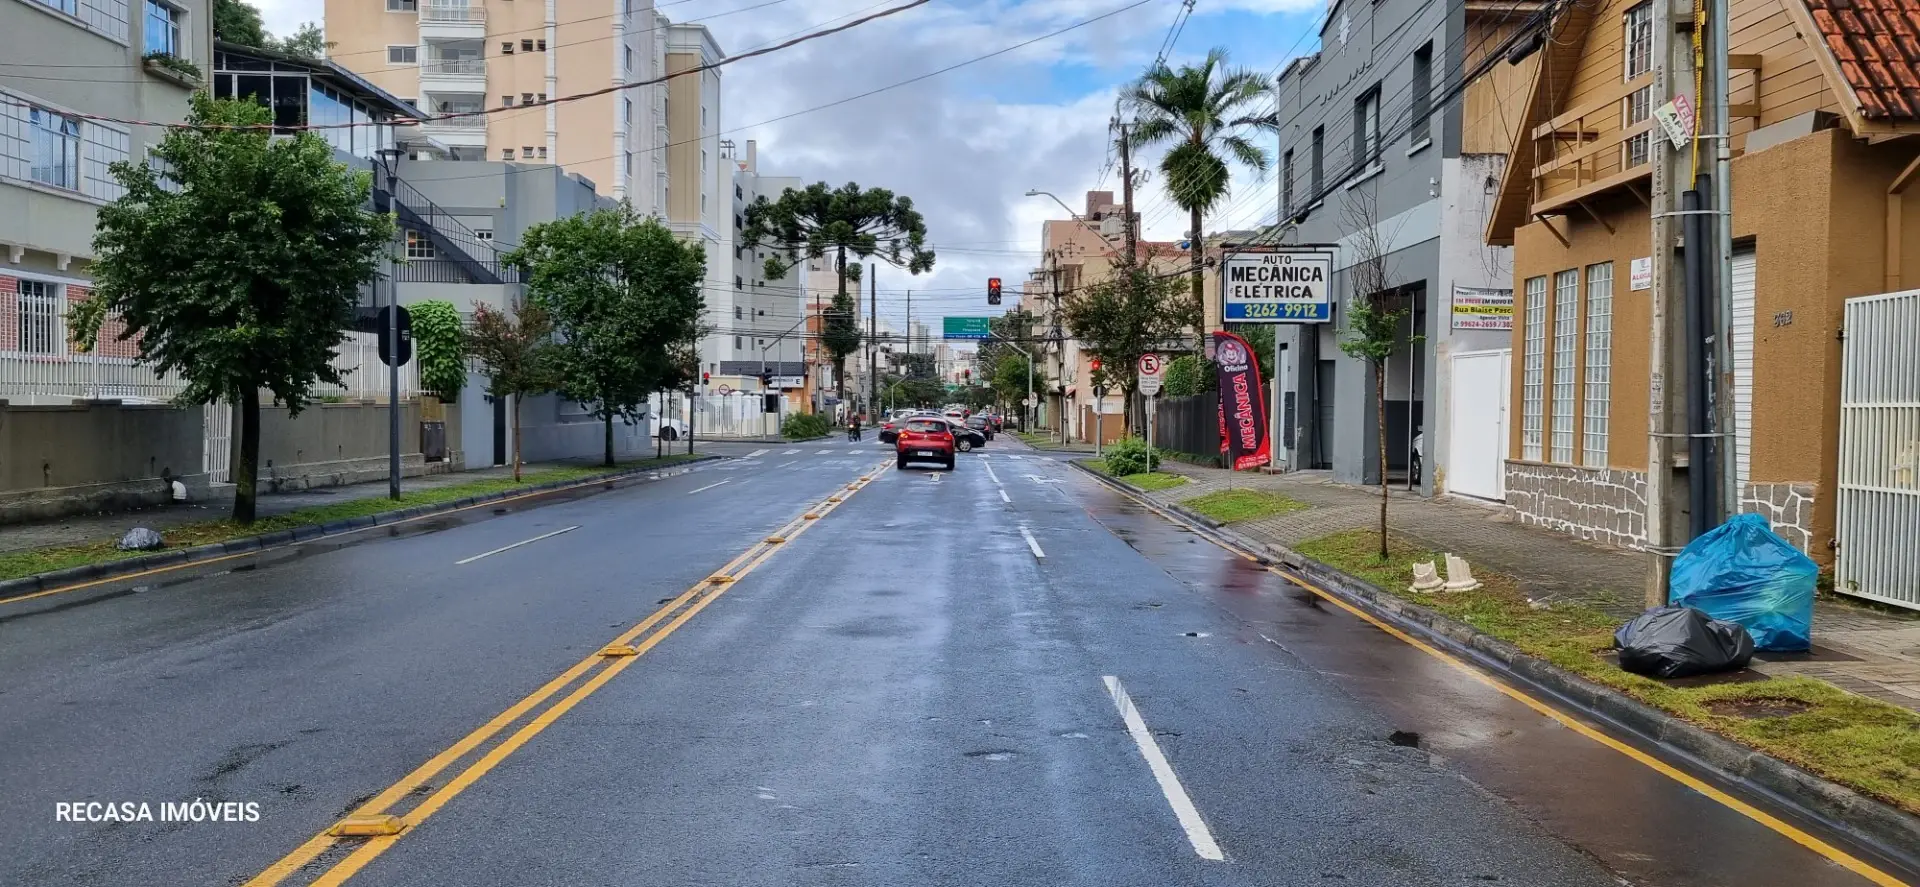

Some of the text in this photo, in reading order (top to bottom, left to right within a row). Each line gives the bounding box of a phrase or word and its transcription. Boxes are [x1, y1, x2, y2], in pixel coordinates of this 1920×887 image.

[1675, 95, 1695, 134] VEN
[1263, 255, 1292, 265] AUTO
[1231, 265, 1323, 282] MECÂNICA
[1235, 283, 1313, 298] ELÉTRICA
[1471, 306, 1493, 314] Blaise
[1232, 372, 1257, 449] MECÂNICA
